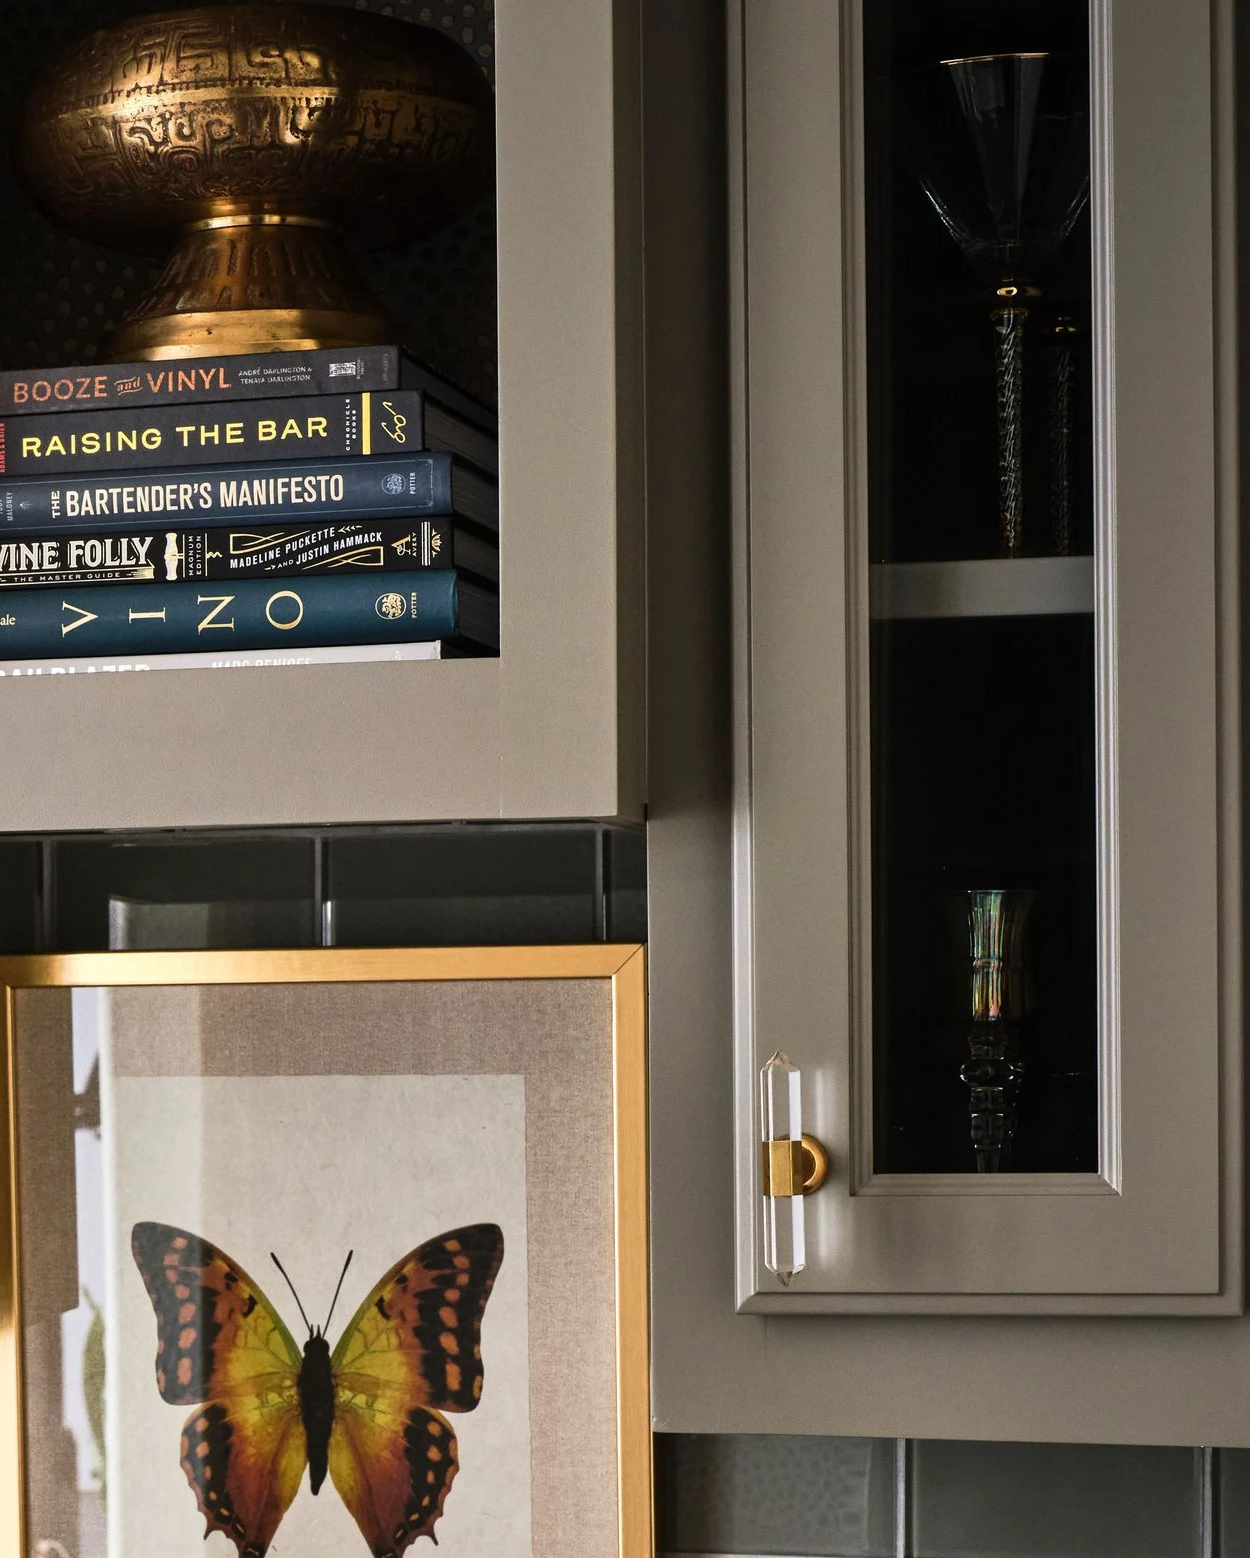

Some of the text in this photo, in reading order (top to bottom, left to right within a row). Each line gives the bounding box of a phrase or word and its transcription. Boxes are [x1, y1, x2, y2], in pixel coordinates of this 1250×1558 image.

[13, 367, 233, 404] BOOZE and VINYL
[240, 374, 311, 385] TENAYA DARLINGTON
[263, 366, 306, 376] DARLINGTON
[22, 416, 328, 458] RAISING THE BAR
[52, 474, 344, 519] THE BARTENDER'S MANIFESTO
[68, 536, 154, 568] FOLLY
[230, 527, 335, 569] MADELINE PUCKETTE
[277, 532, 383, 569] AND JUSTIN HAMMACK
[61, 590, 304, 637] VINO
